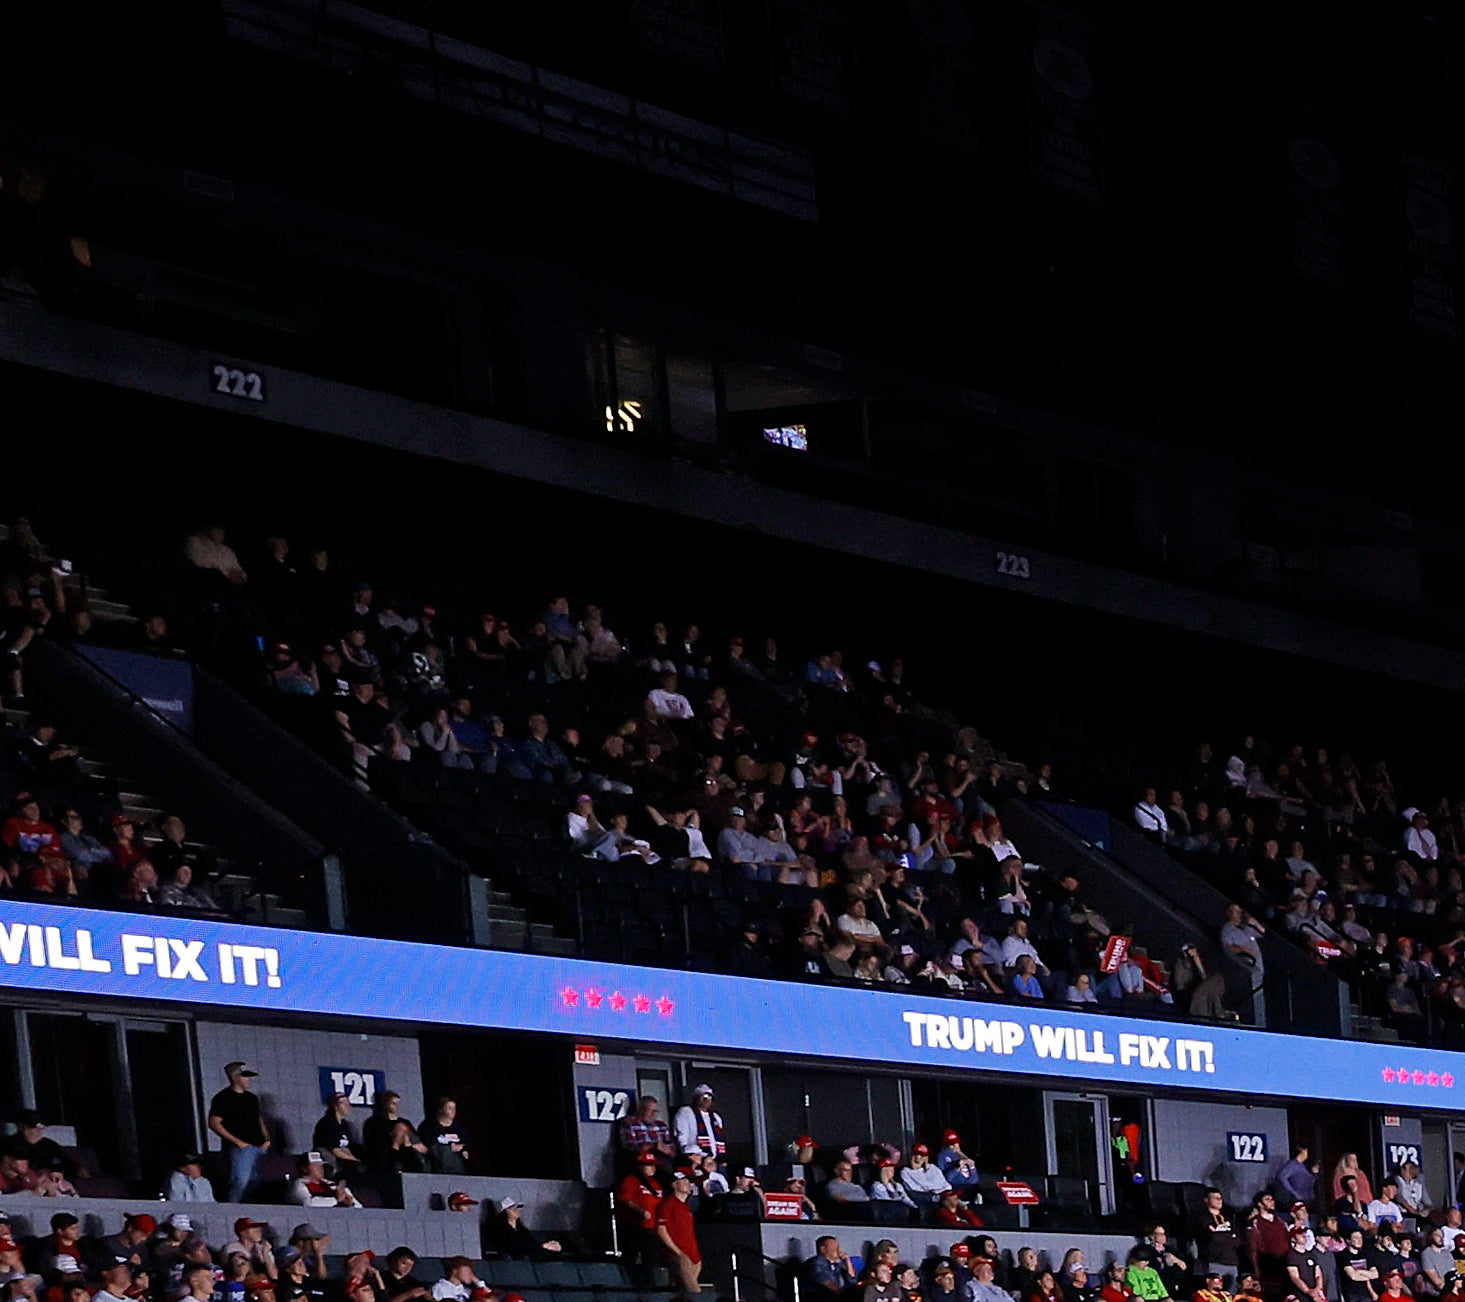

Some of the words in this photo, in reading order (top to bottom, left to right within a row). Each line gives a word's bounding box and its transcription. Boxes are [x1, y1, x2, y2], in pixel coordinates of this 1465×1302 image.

[213, 364, 264, 400] 222
[122, 933, 208, 982] FIX
[218, 943, 282, 989] IT!
[903, 1012, 1024, 1055] TRUMP
[1029, 1023, 1115, 1064] WILL
[1119, 1033, 1172, 1071] FIX
[1176, 1040, 1216, 1073] IT!
[331, 1070, 377, 1106] 121
[585, 1089, 631, 1121] 122
[1231, 1133, 1266, 1161] 122
